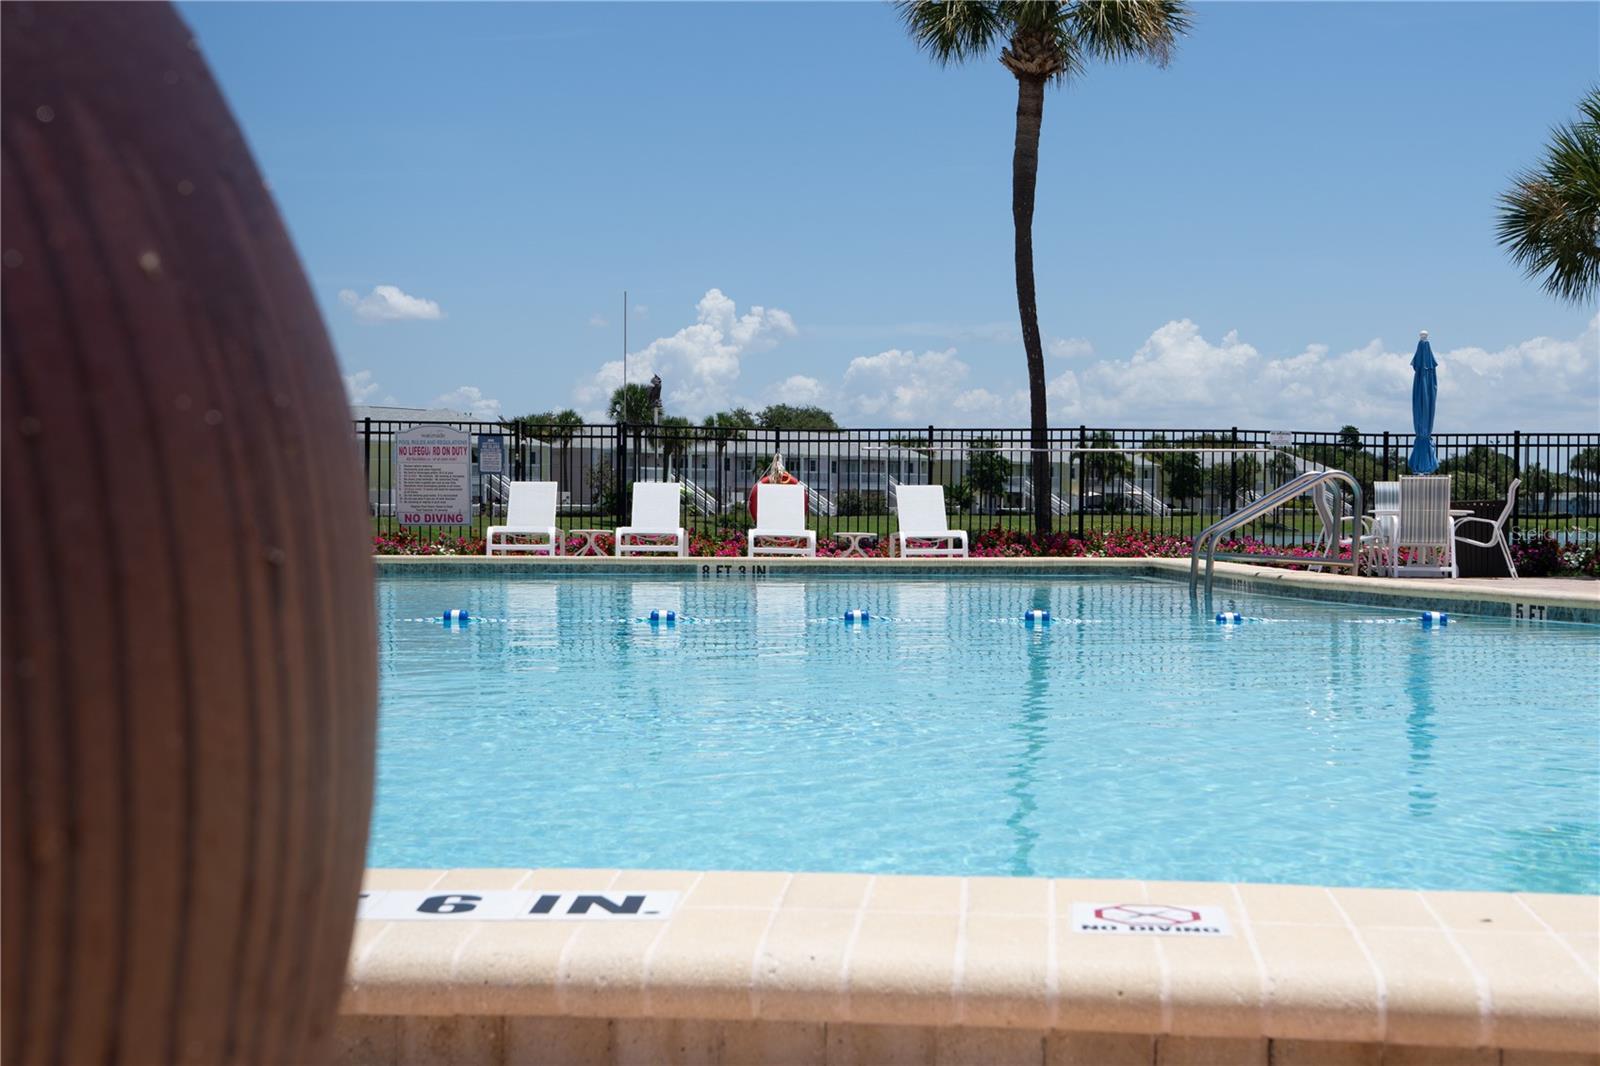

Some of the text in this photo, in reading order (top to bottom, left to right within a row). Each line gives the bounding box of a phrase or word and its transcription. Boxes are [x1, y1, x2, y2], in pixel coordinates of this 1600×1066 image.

[399, 446, 408, 456] NO
[441, 446, 451, 456] ON
[451, 446, 468, 456] DUTY
[404, 513, 464, 523] NO DIVING
[716, 564, 732, 575] FT
[752, 564, 767, 575] IN
[1515, 602, 1545, 621] 5 FT
[416, 894, 661, 915] 6 IN.
[1081, 923, 1221, 934] NO DIVING
